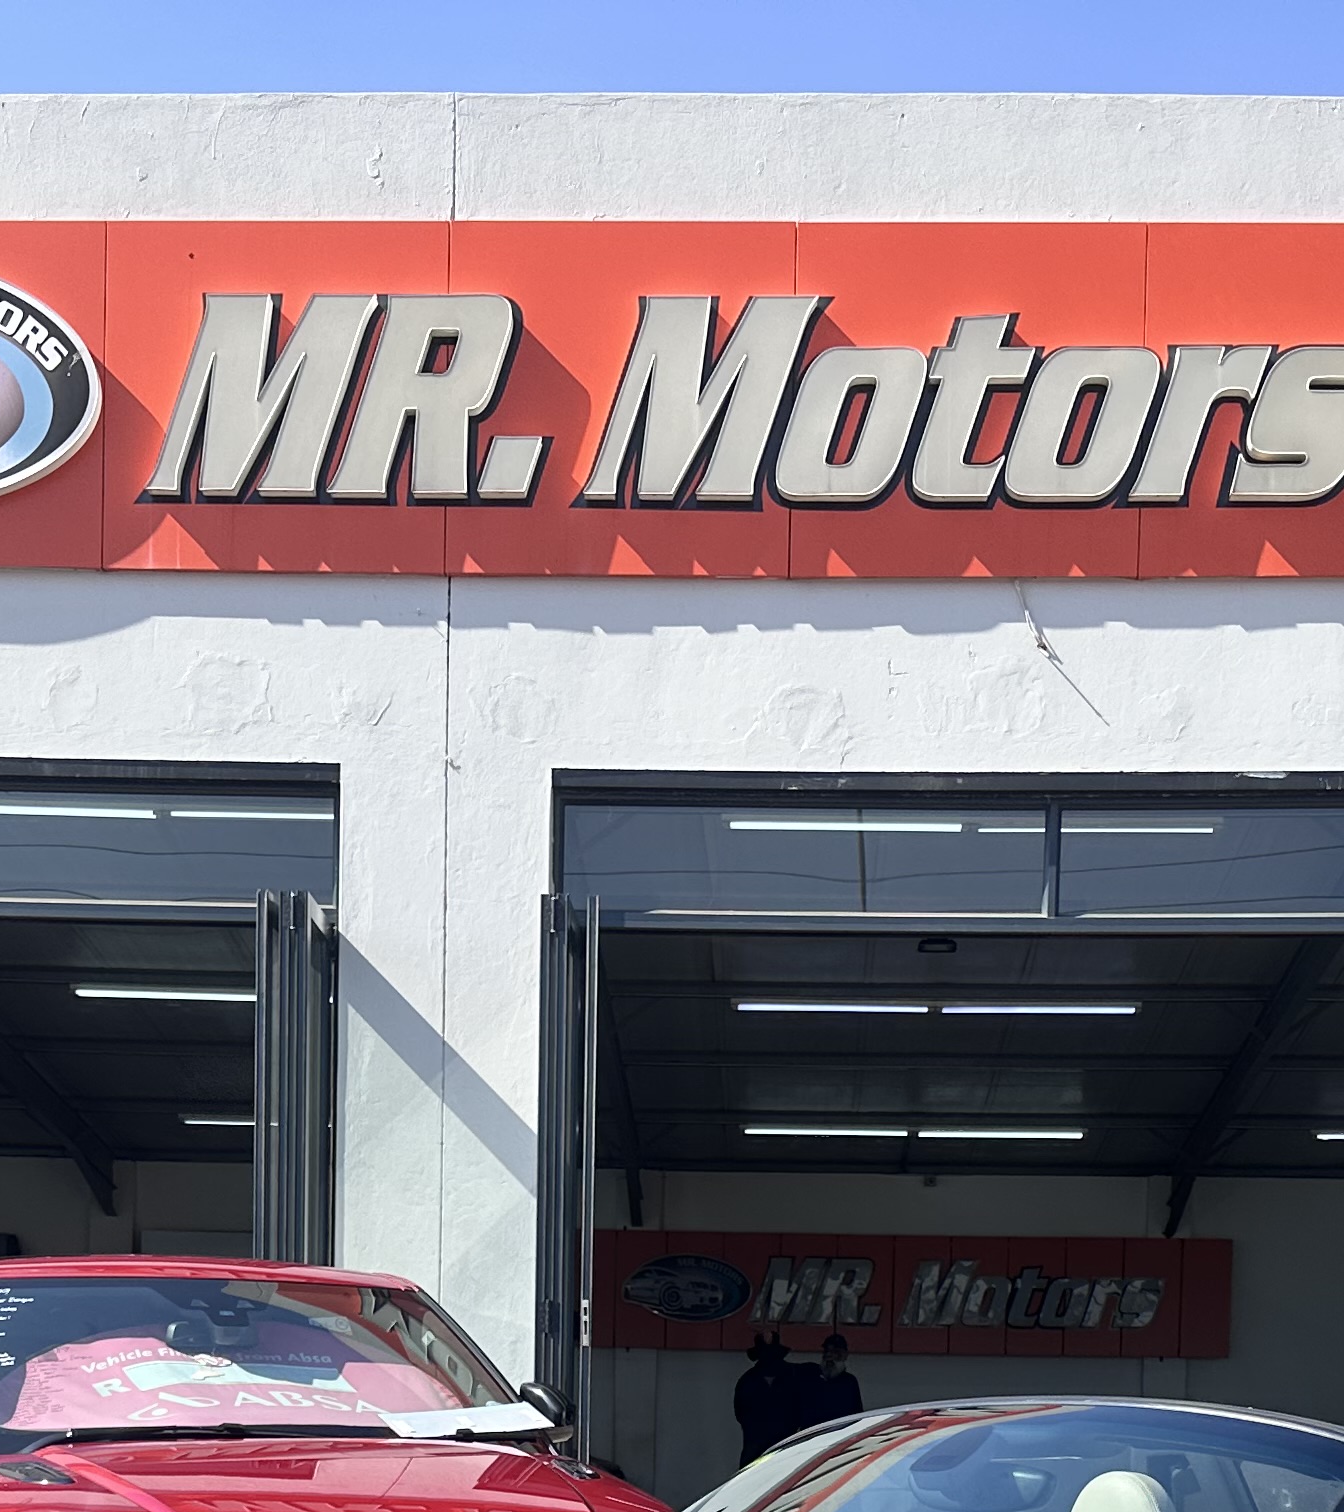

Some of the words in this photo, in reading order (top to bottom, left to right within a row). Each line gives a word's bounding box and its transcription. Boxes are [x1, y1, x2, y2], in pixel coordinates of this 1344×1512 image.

[144, 293, 546, 500] MR.
[748, 1256, 881, 1327] MR.
[897, 1258, 1167, 1331] Motors
[81, 1348, 152, 1374] Vehicle
[288, 1352, 333, 1363] Absa
[91, 1377, 131, 1398] R
[233, 1390, 392, 1415] ABSA
